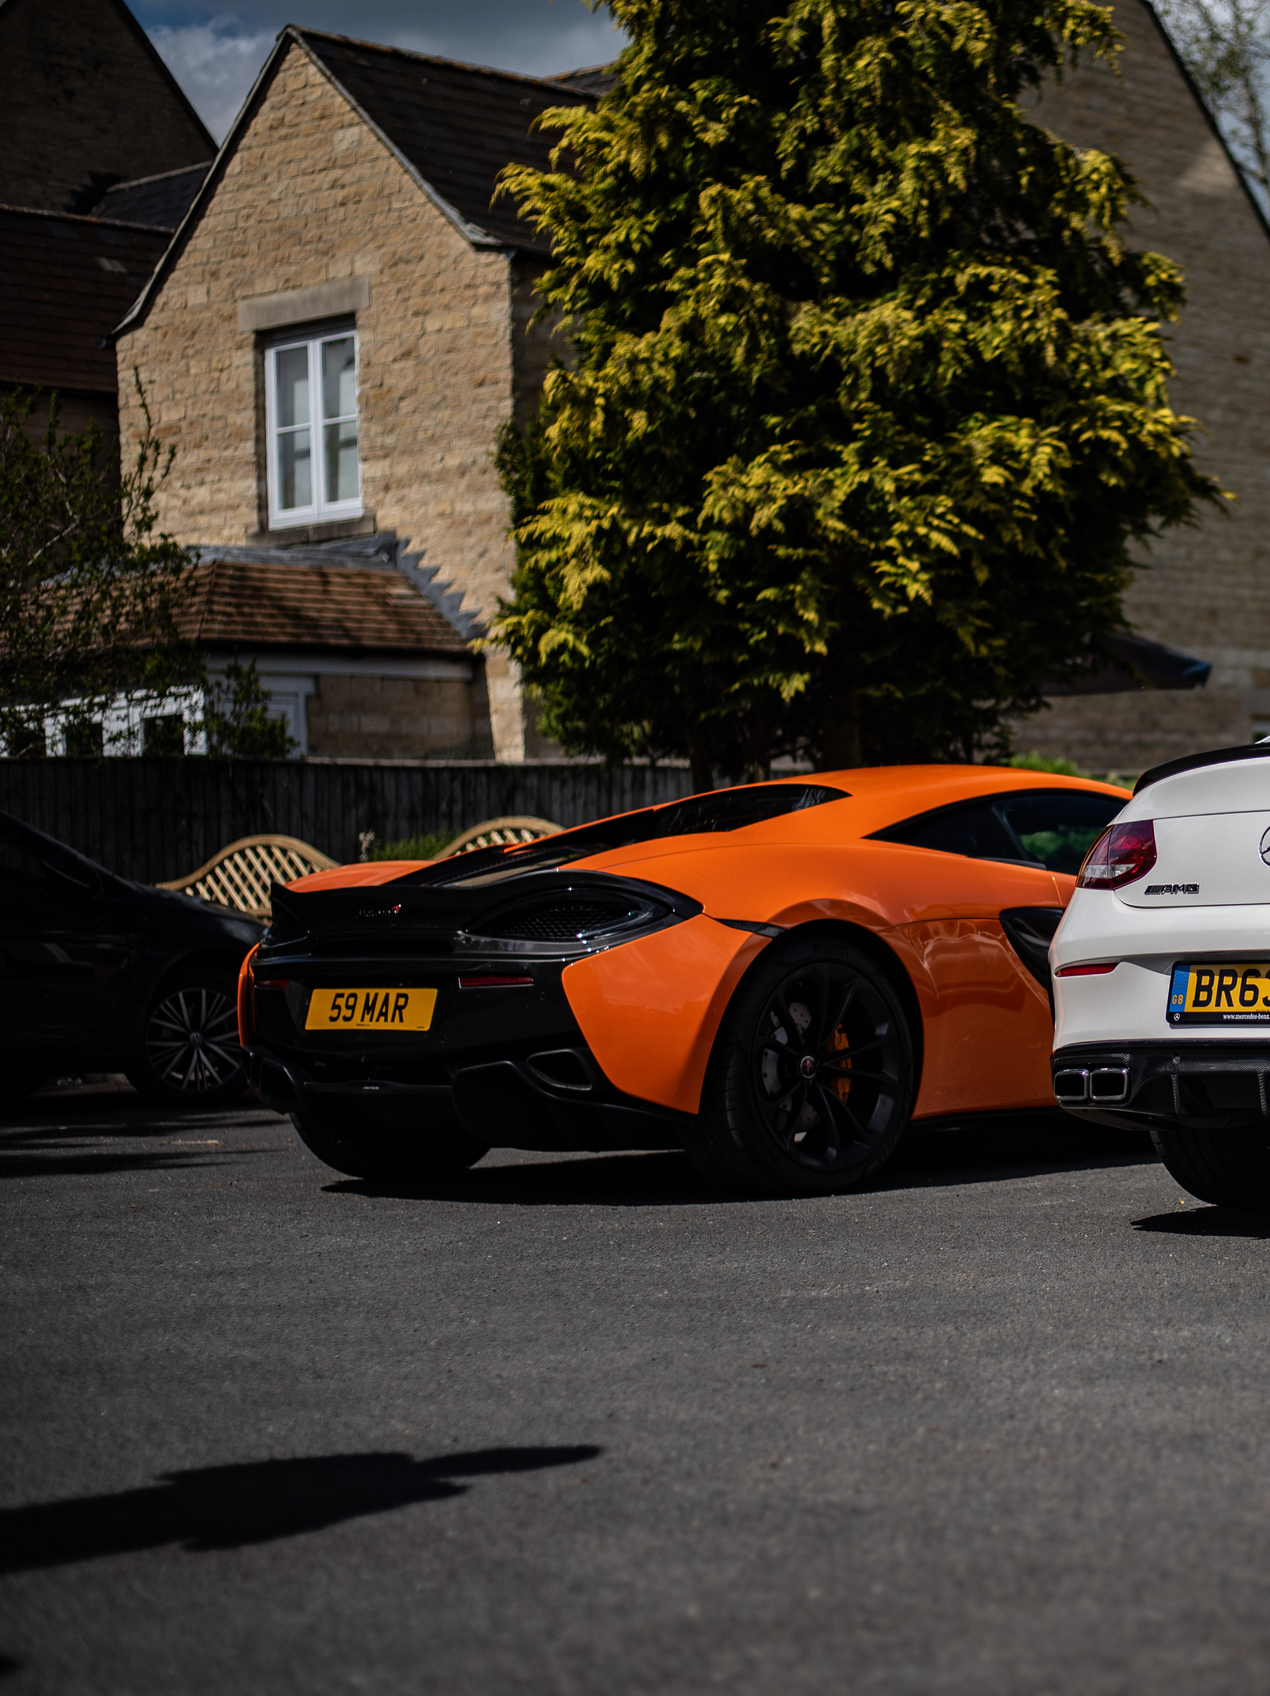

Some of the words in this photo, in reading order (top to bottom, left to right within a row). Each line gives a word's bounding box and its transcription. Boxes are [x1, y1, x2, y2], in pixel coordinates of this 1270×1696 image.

[329, 992, 358, 1022] 59
[360, 992, 409, 1023] MAR
[1172, 994, 1184, 1005] GB
